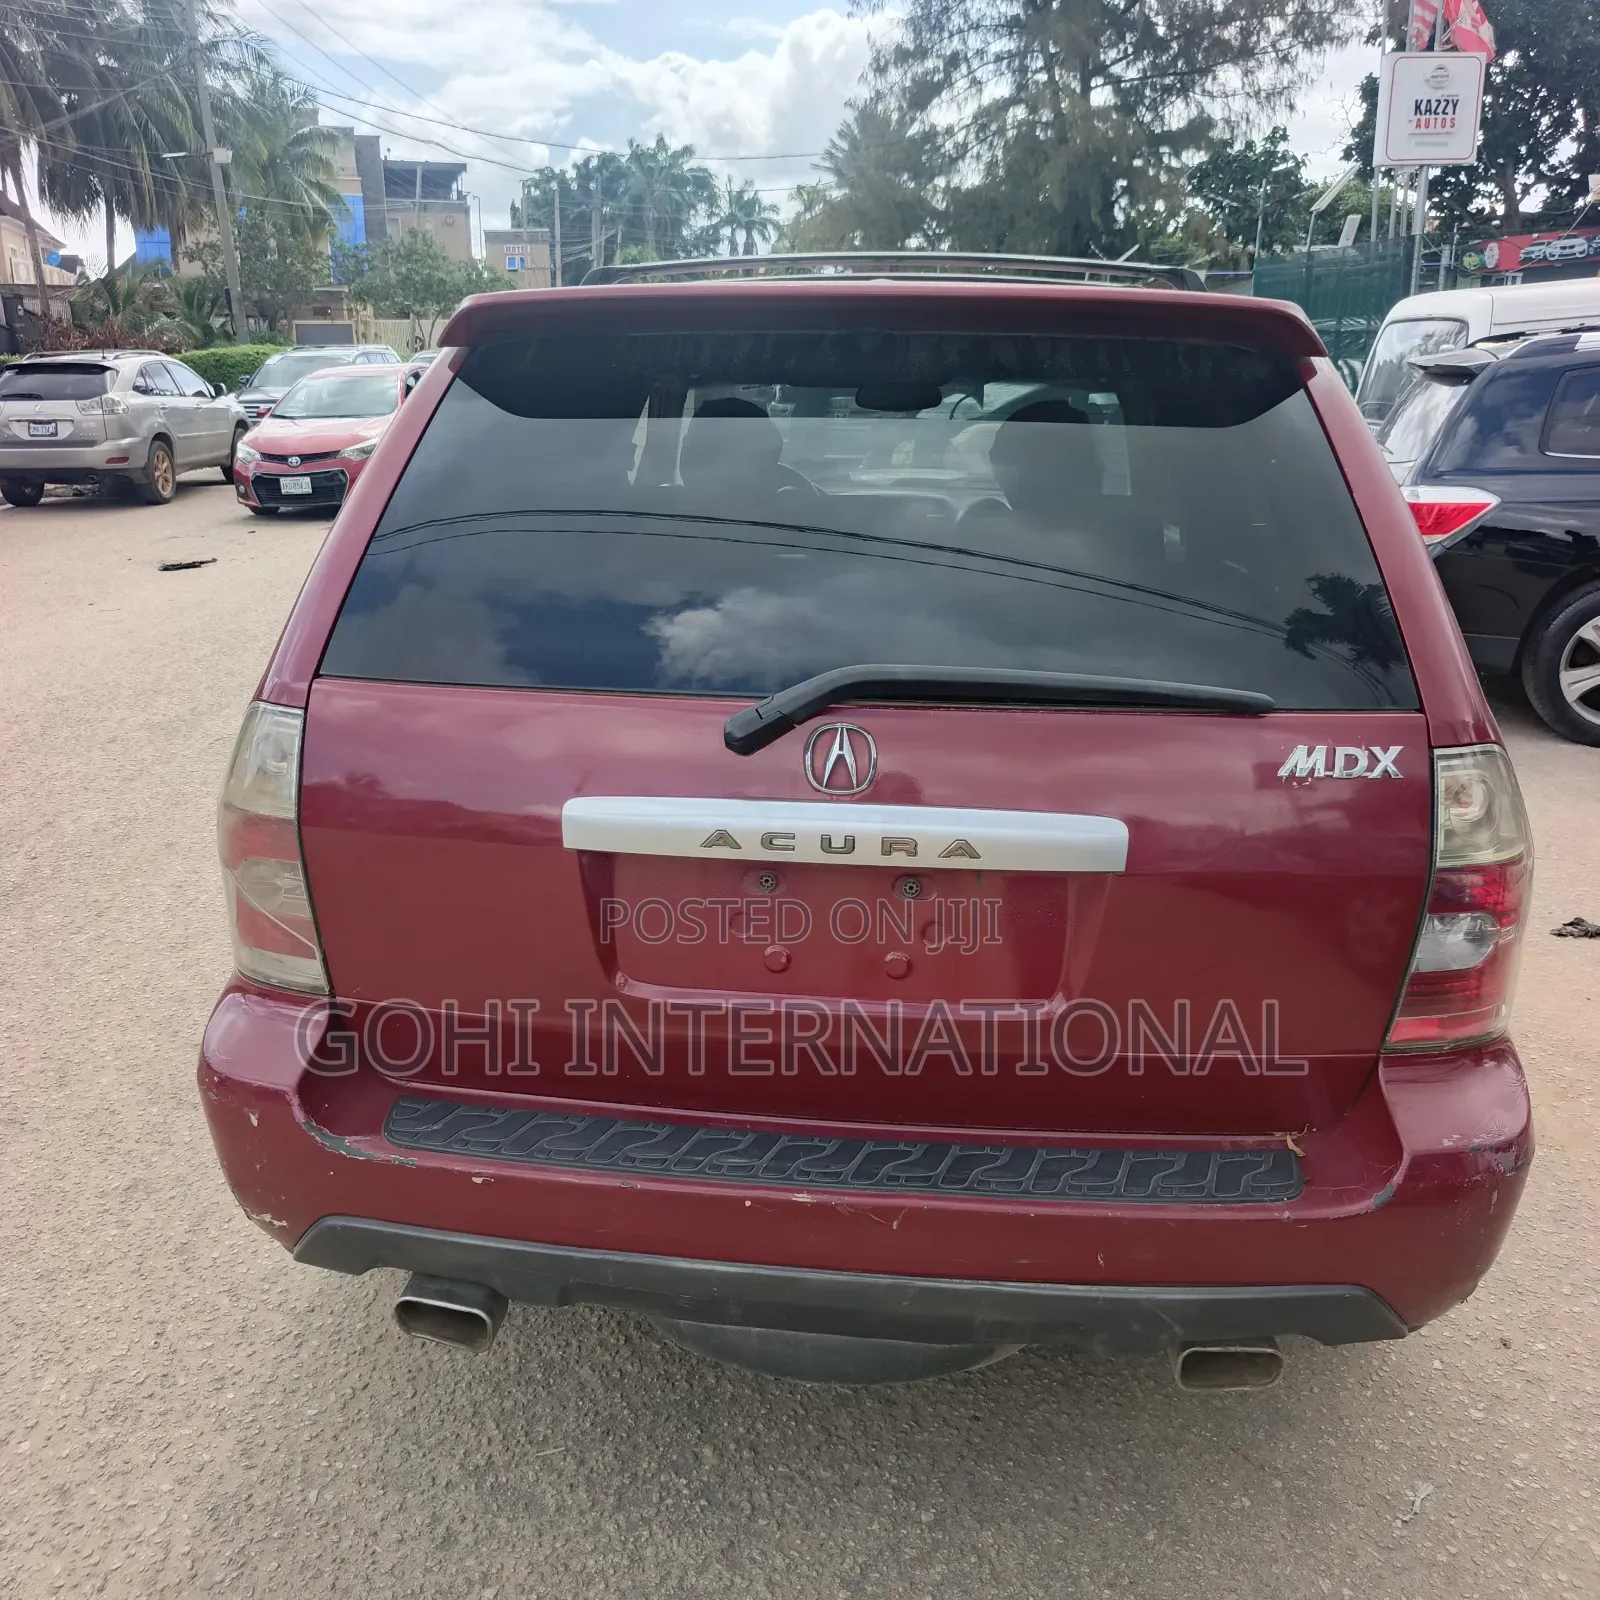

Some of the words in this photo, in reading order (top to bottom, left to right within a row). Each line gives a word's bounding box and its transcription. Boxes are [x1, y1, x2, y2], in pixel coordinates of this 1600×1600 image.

[1414, 98, 1460, 116] KAZZY
[1415, 117, 1456, 130] AUTOS
[1277, 745, 1404, 778] MDX
[699, 829, 983, 860] ACURA
